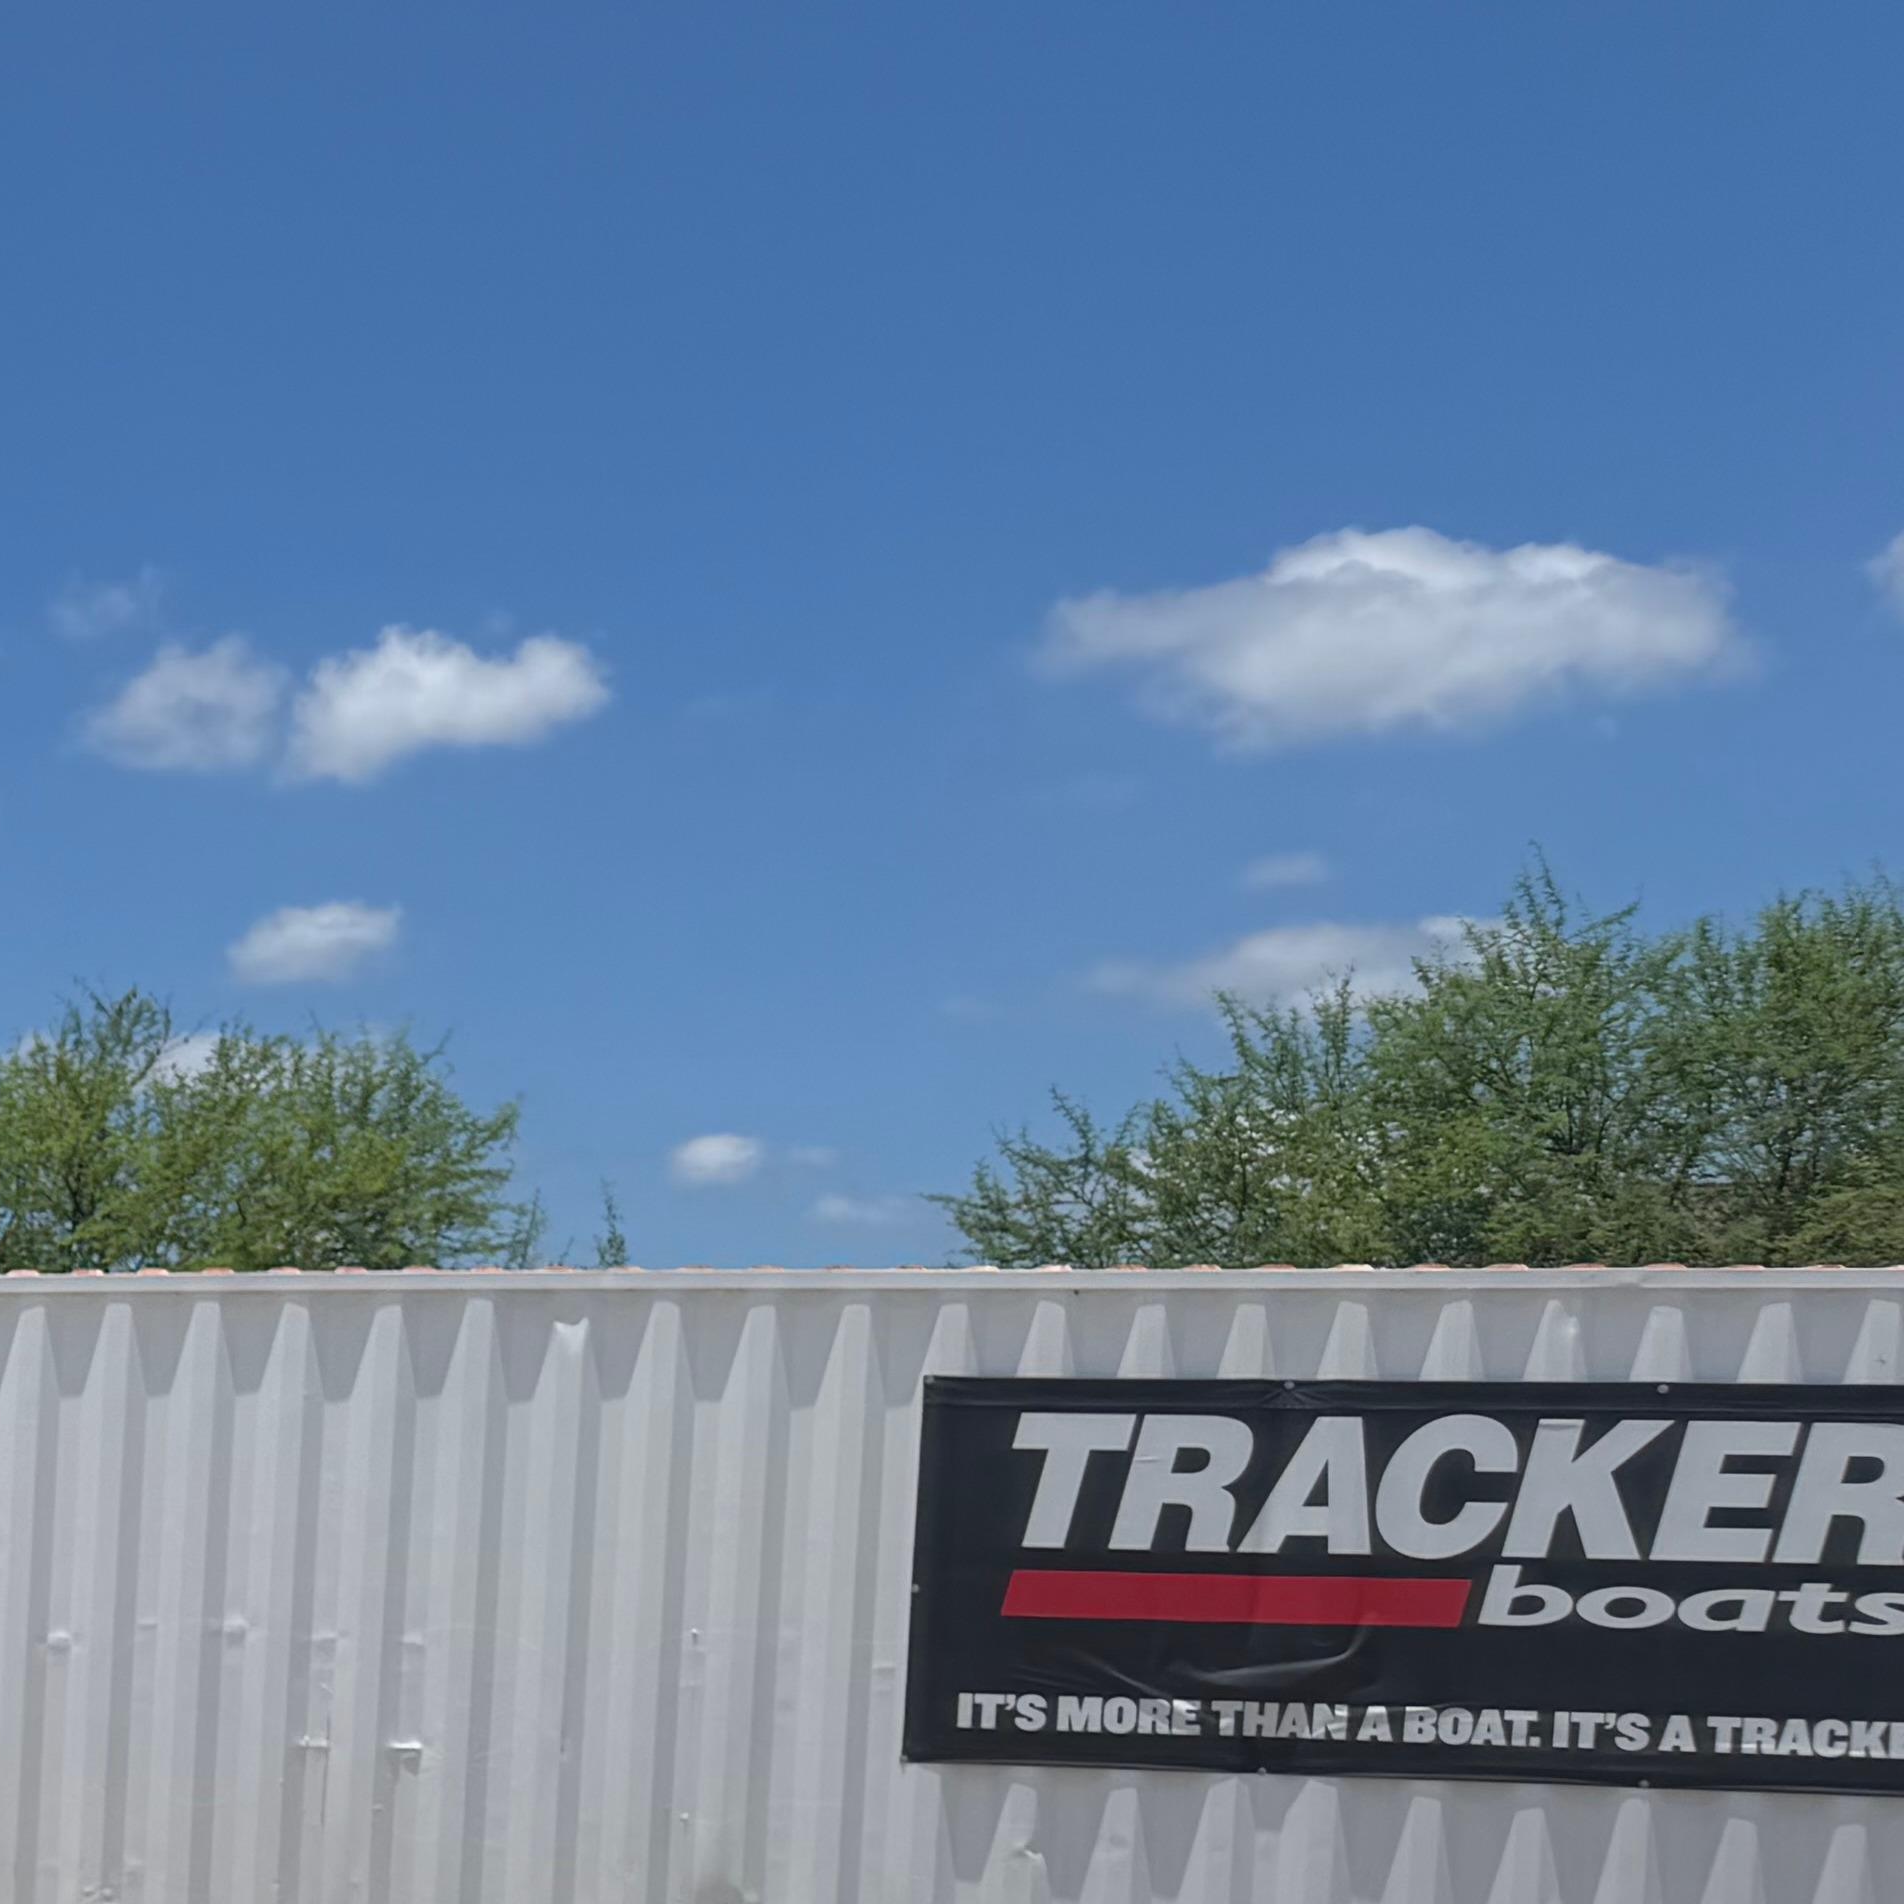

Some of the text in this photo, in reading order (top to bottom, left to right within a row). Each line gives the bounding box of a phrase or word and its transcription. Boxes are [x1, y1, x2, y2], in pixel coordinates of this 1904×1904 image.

[1011, 1412, 1904, 1565] TRACKER
[1477, 1564, 1904, 1635] boats
[956, 1692, 1047, 1732] IT'S
[1056, 1696, 1201, 1736] MORE
[1211, 1700, 1347, 1741] THAN
[1356, 1706, 1393, 1743] A
[1403, 1706, 1541, 1747] BOAT.
[1552, 1711, 1650, 1751] IT'S
[1658, 1715, 1697, 1752] A
